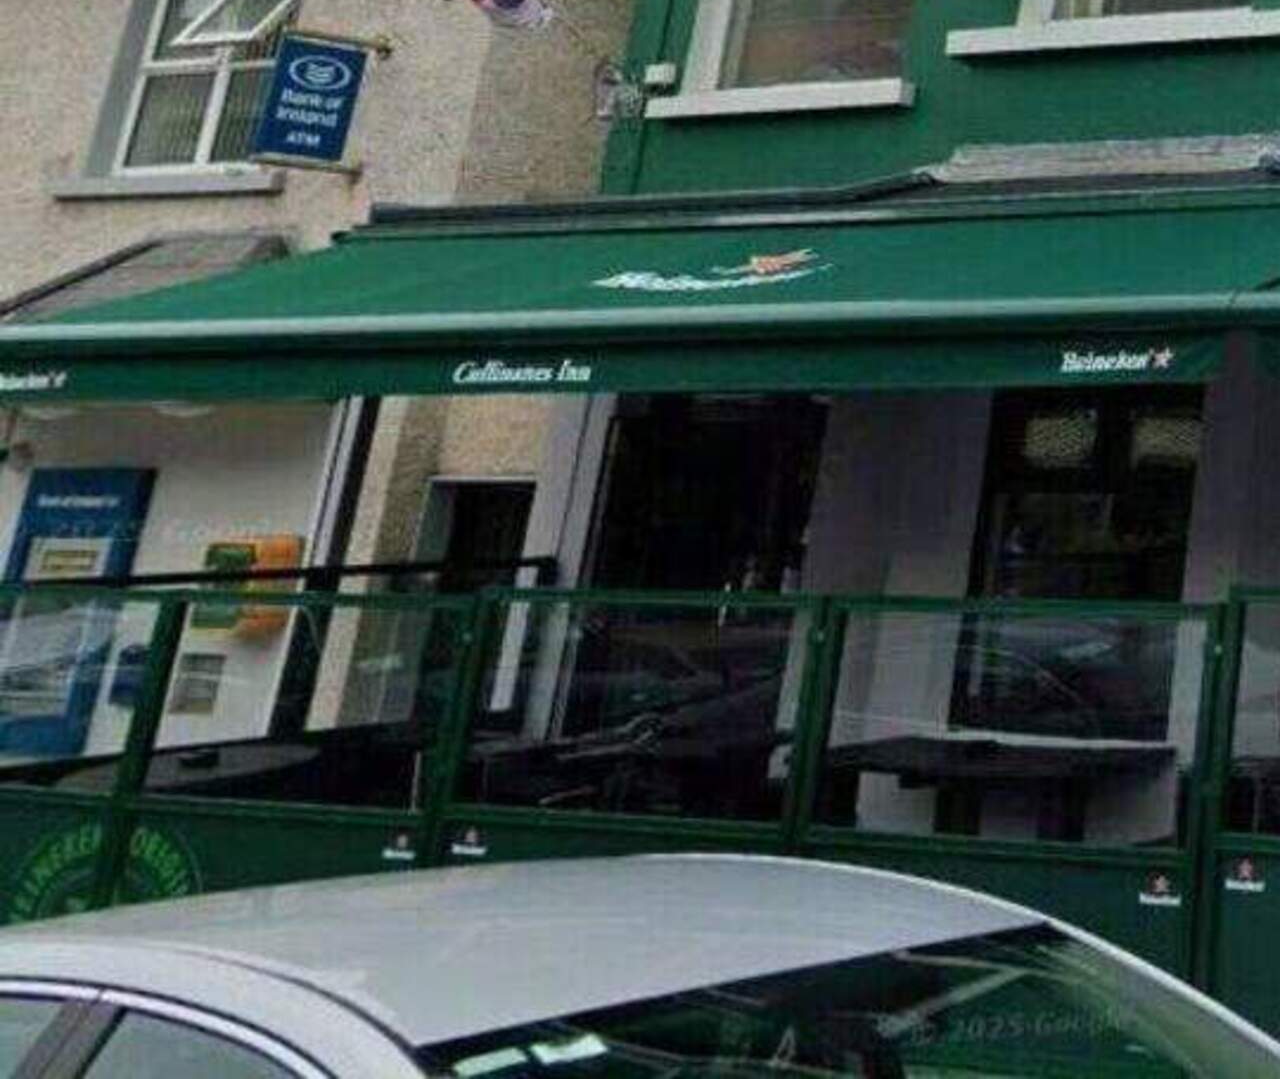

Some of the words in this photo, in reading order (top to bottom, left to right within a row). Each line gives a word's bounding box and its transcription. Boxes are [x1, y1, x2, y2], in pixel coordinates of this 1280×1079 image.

[281, 87, 322, 108] Bank
[276, 106, 338, 128] Ireland
[286, 131, 321, 148] ATM
[556, 358, 592, 381] Inn
